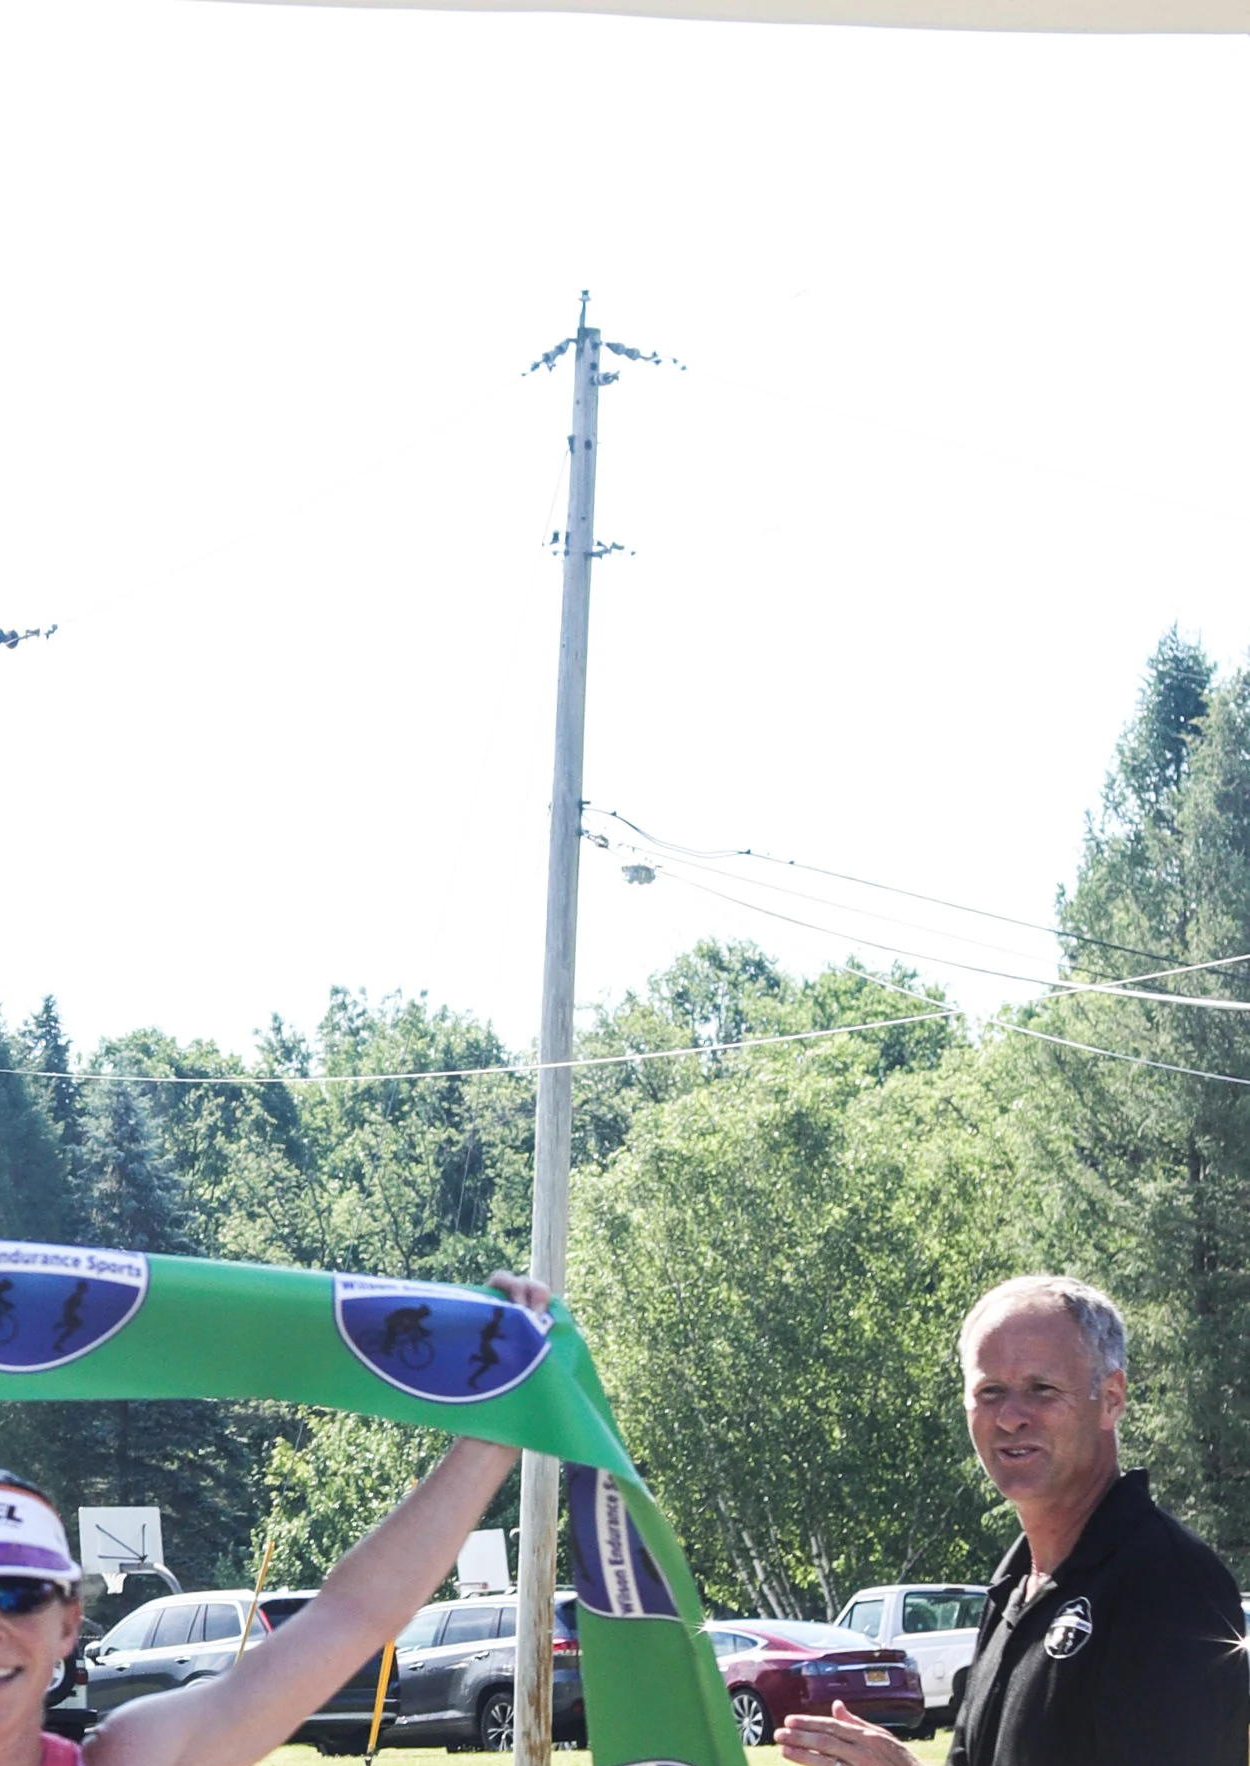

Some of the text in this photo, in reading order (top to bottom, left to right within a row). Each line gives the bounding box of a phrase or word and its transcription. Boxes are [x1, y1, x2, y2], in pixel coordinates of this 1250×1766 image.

[85, 1254, 143, 1279] Sports
[606, 1493, 625, 1566] Endurance
[615, 1568, 634, 1615] Wilson
